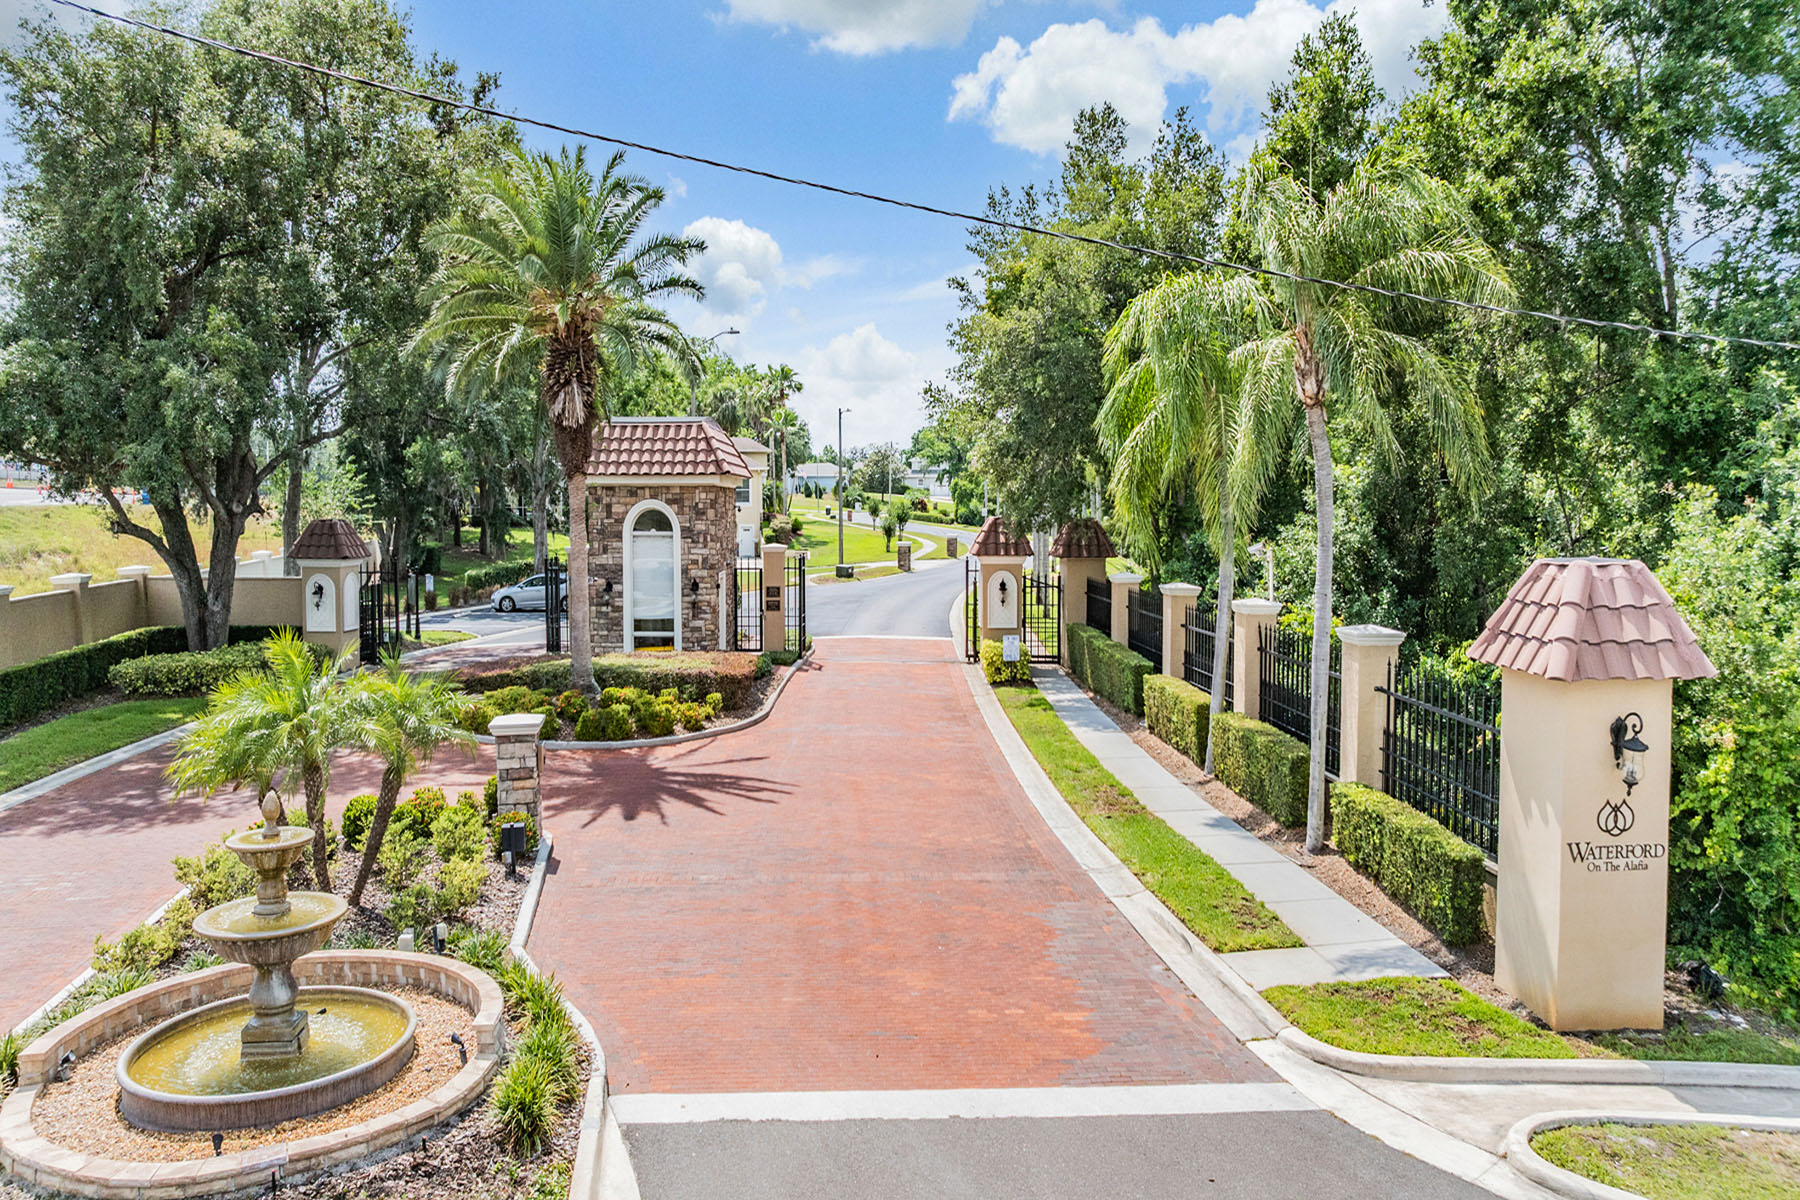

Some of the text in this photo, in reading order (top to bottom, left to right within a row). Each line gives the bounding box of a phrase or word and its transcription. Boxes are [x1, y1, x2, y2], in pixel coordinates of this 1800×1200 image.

[1567, 842, 1665, 863] WATERFORD
[1587, 860, 1648, 872] On The Alafia
